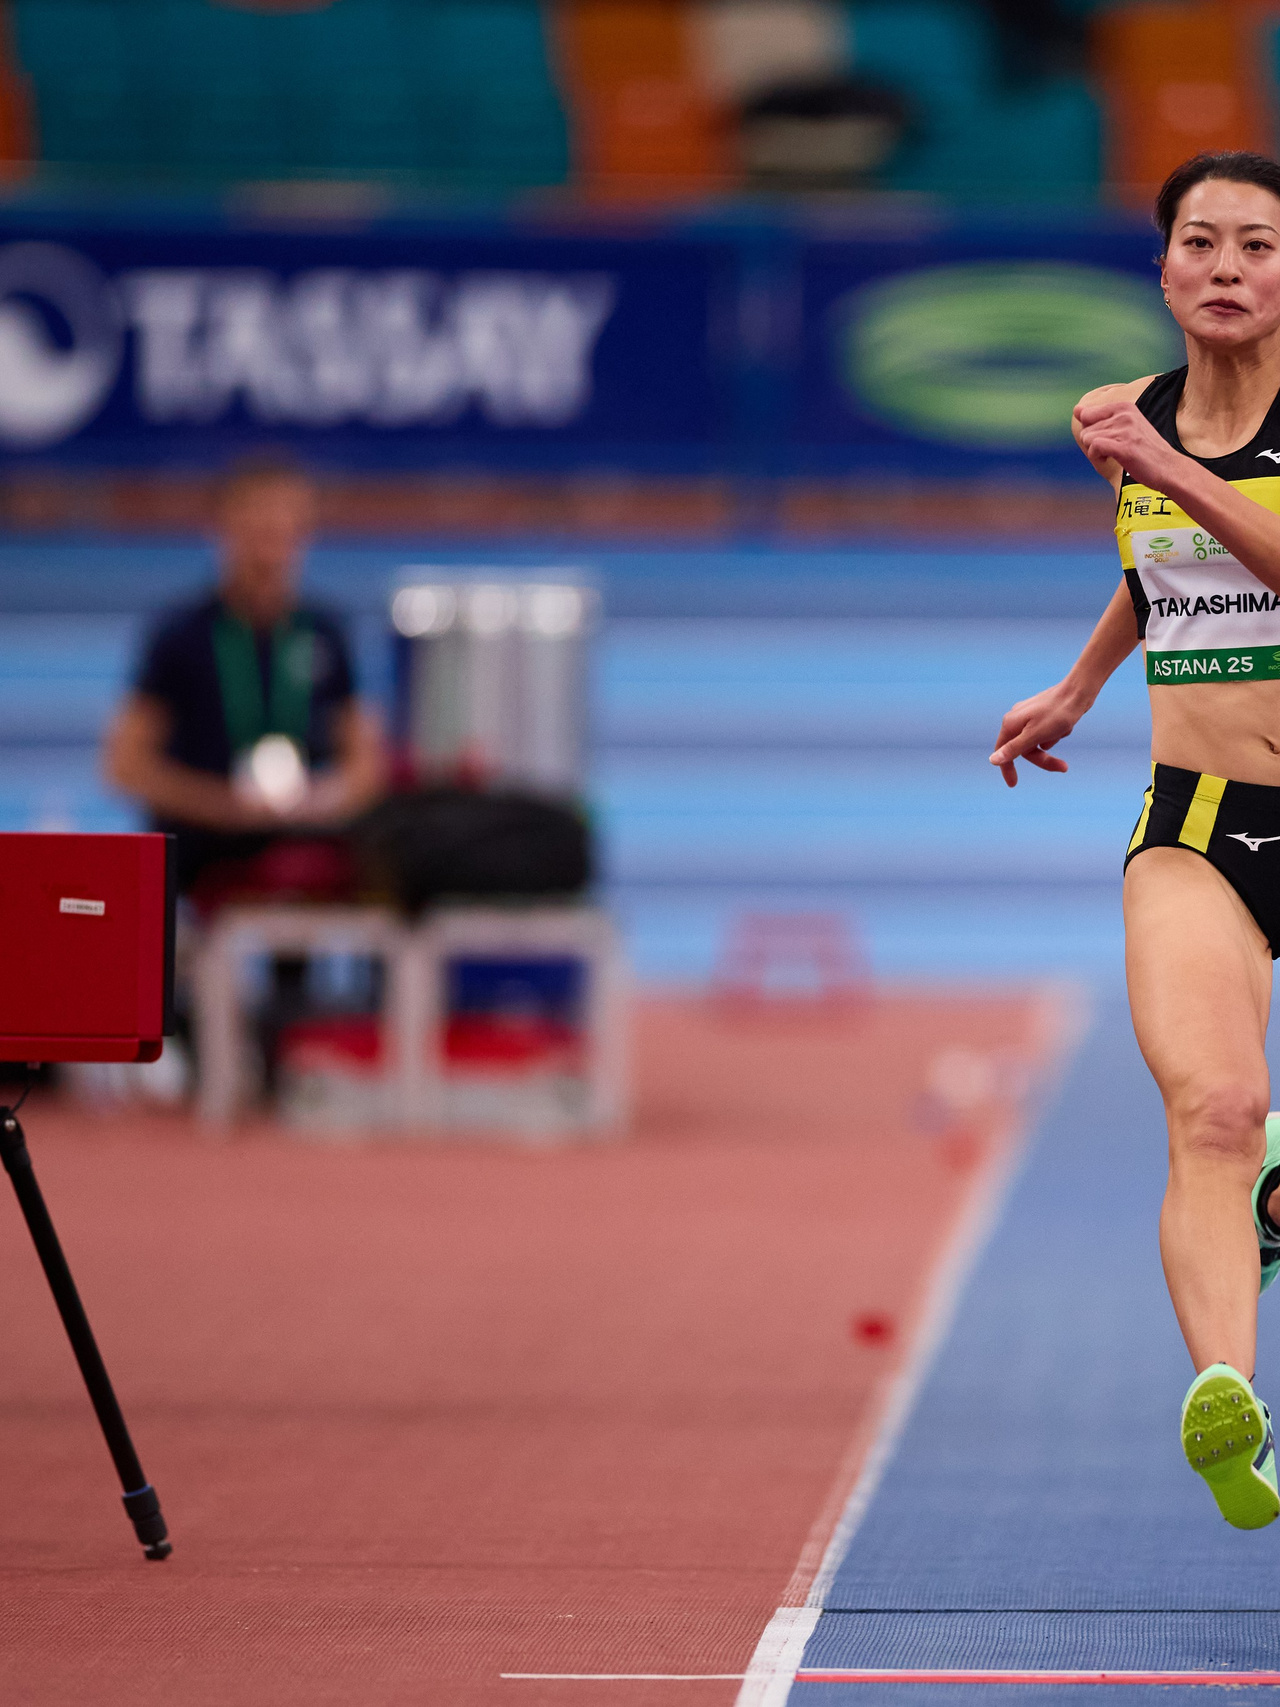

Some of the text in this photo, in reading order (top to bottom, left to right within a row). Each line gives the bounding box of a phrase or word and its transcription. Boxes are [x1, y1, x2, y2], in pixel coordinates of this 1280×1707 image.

[118, 270, 616, 426] TASSAY
[1121, 496, 1172, 519] 九電工
[1154, 656, 1254, 677] ASTANA 25
